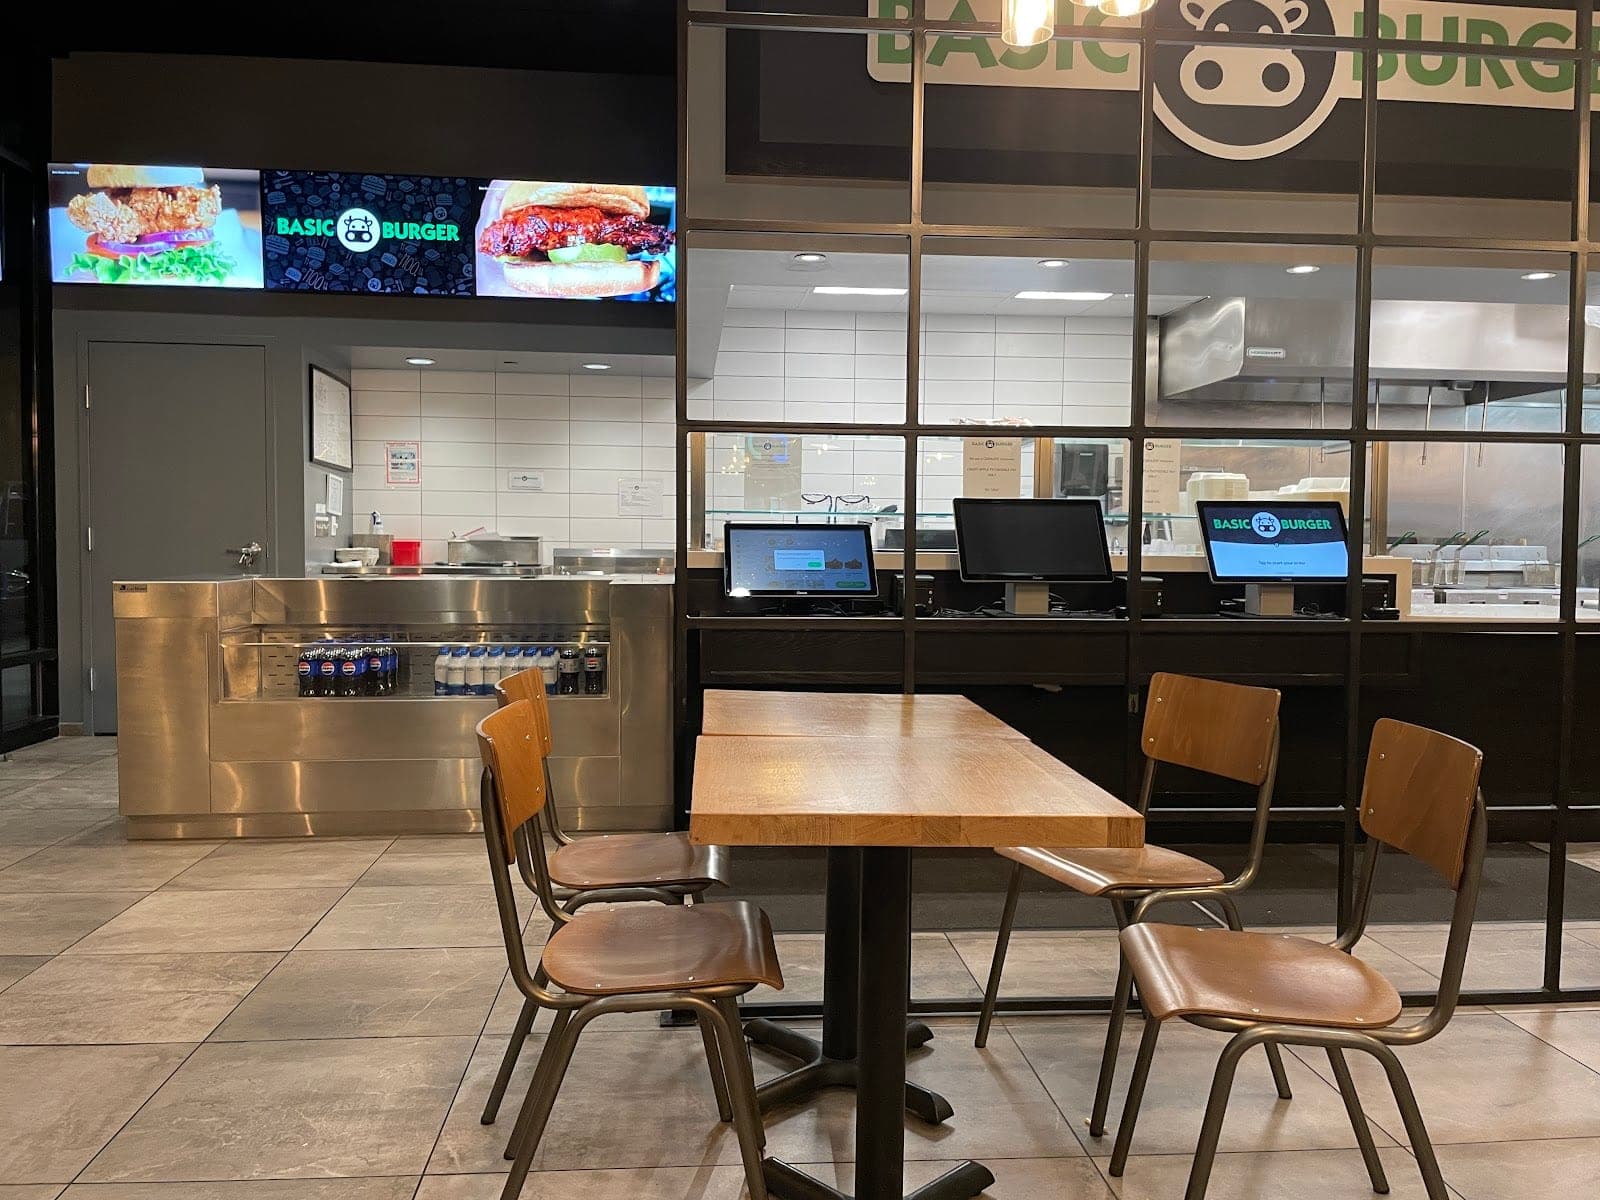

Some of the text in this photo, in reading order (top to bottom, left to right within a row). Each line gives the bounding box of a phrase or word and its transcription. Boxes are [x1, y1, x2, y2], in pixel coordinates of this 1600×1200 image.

[1352, 11, 1600, 94] BURG
[276, 217, 460, 241] BASIC BURGER
[1213, 519, 1332, 529] BASIC BURGER
